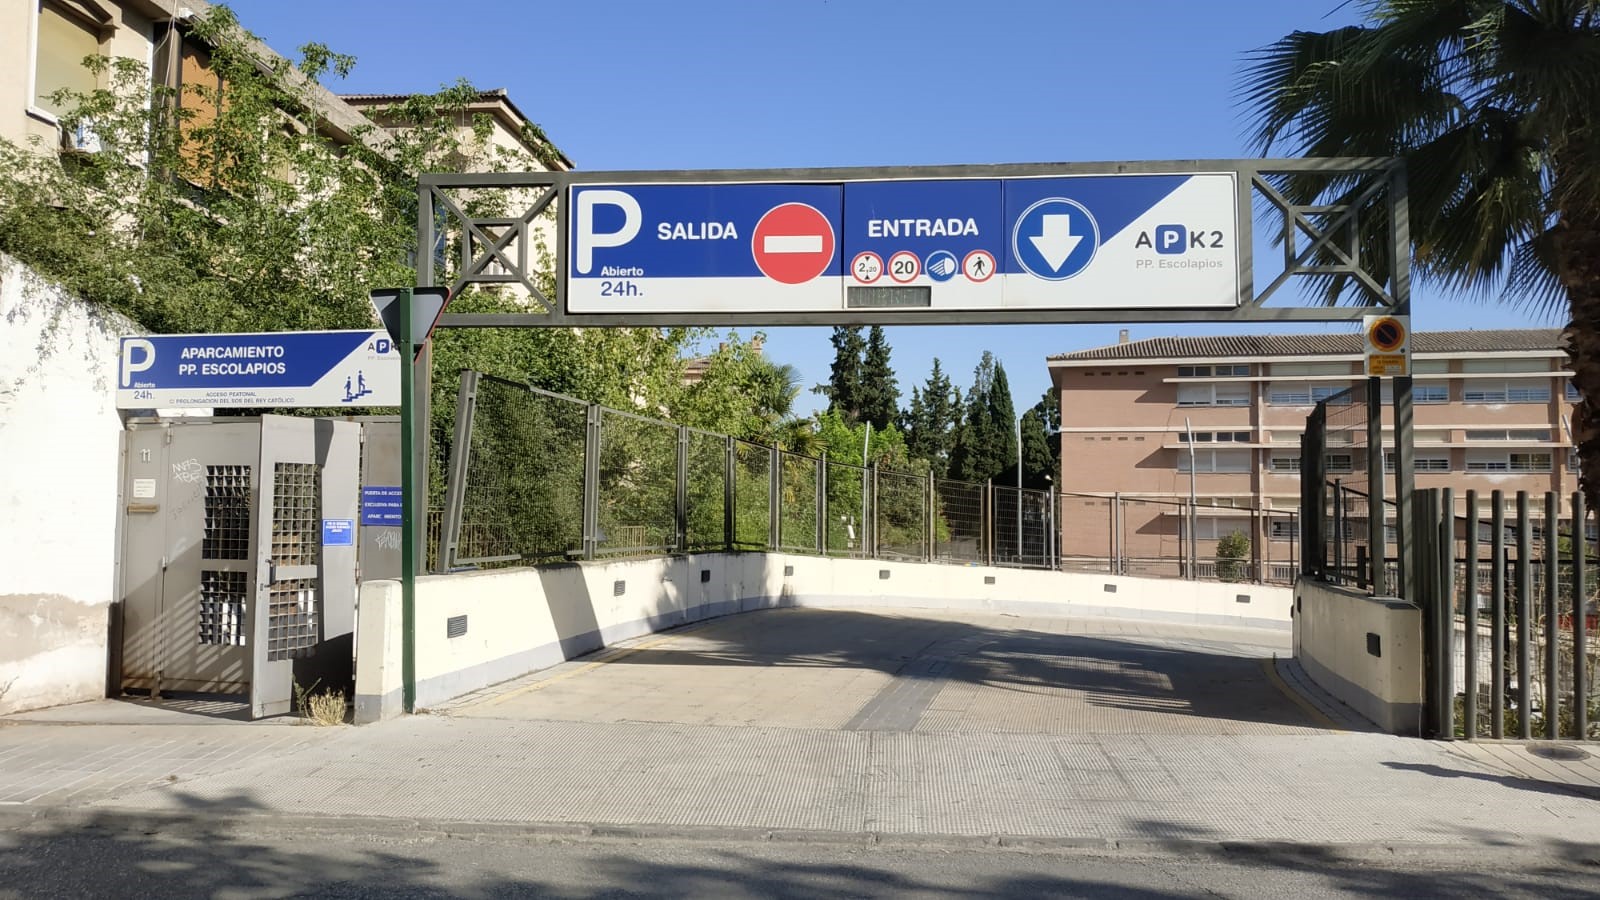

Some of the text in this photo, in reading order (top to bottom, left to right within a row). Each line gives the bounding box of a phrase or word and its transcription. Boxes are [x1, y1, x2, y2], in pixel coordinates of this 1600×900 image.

[577, 190, 642, 275] P
[657, 222, 738, 241] SALIDA
[868, 218, 979, 238] ENTRADA
[601, 265, 644, 277] Abierto
[894, 261, 915, 274] 20
[1136, 259, 1223, 271] PP. Escolapios
[601, 281, 644, 297] 24h.
[181, 346, 285, 360] APARCAMIENTO
[122, 339, 156, 387] P
[179, 362, 286, 376] PP. ESCOLAPIOS
[141, 448, 151, 462] 11
